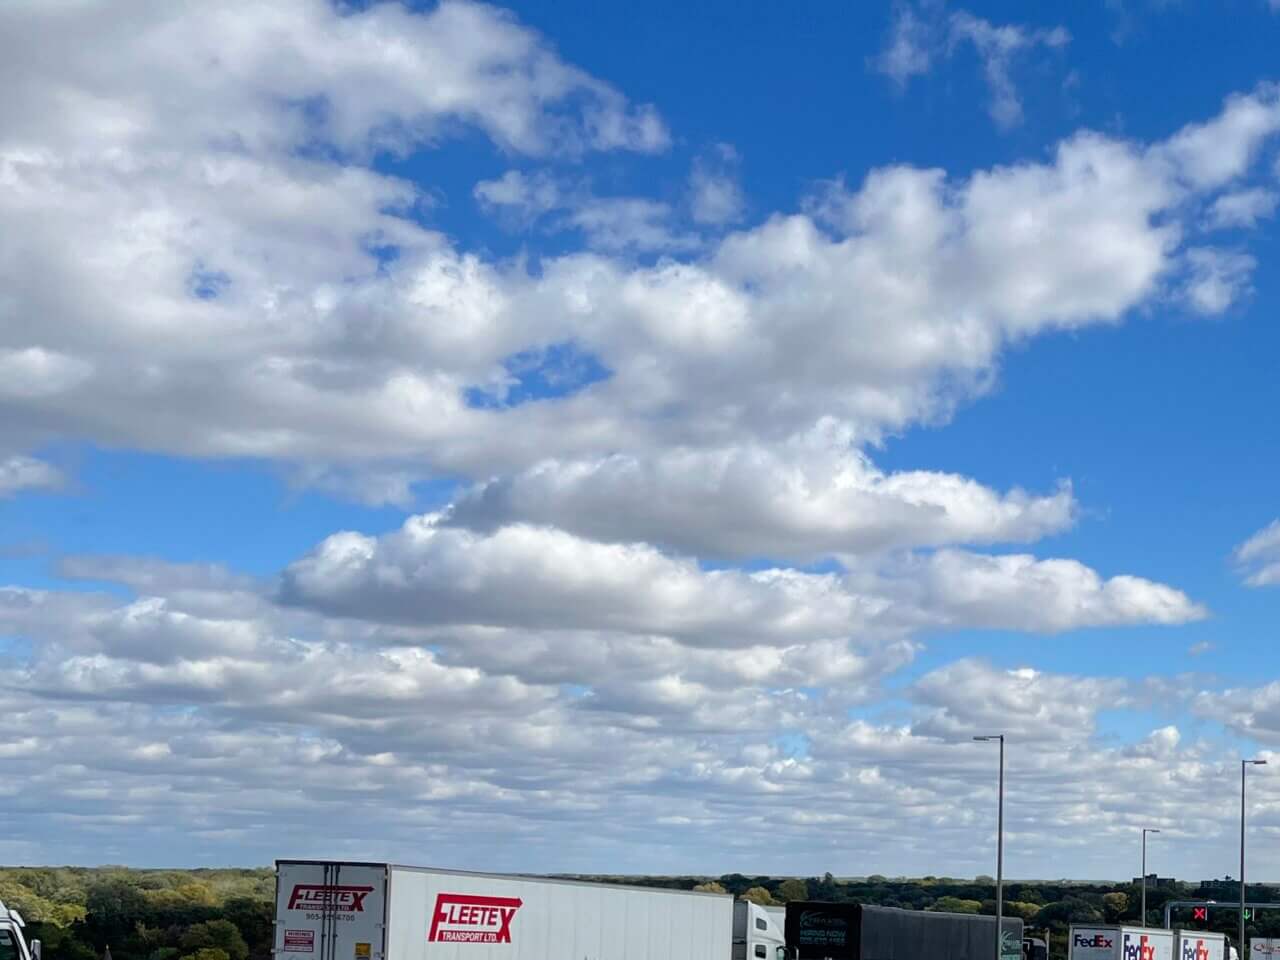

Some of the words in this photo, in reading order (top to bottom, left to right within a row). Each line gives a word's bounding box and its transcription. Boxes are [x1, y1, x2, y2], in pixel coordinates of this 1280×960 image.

[288, 885, 375, 911] FLEETEX
[428, 894, 523, 943] FLEETEX
[442, 932, 482, 941] TRANSPORT
[1074, 935, 1113, 948] FedEx
